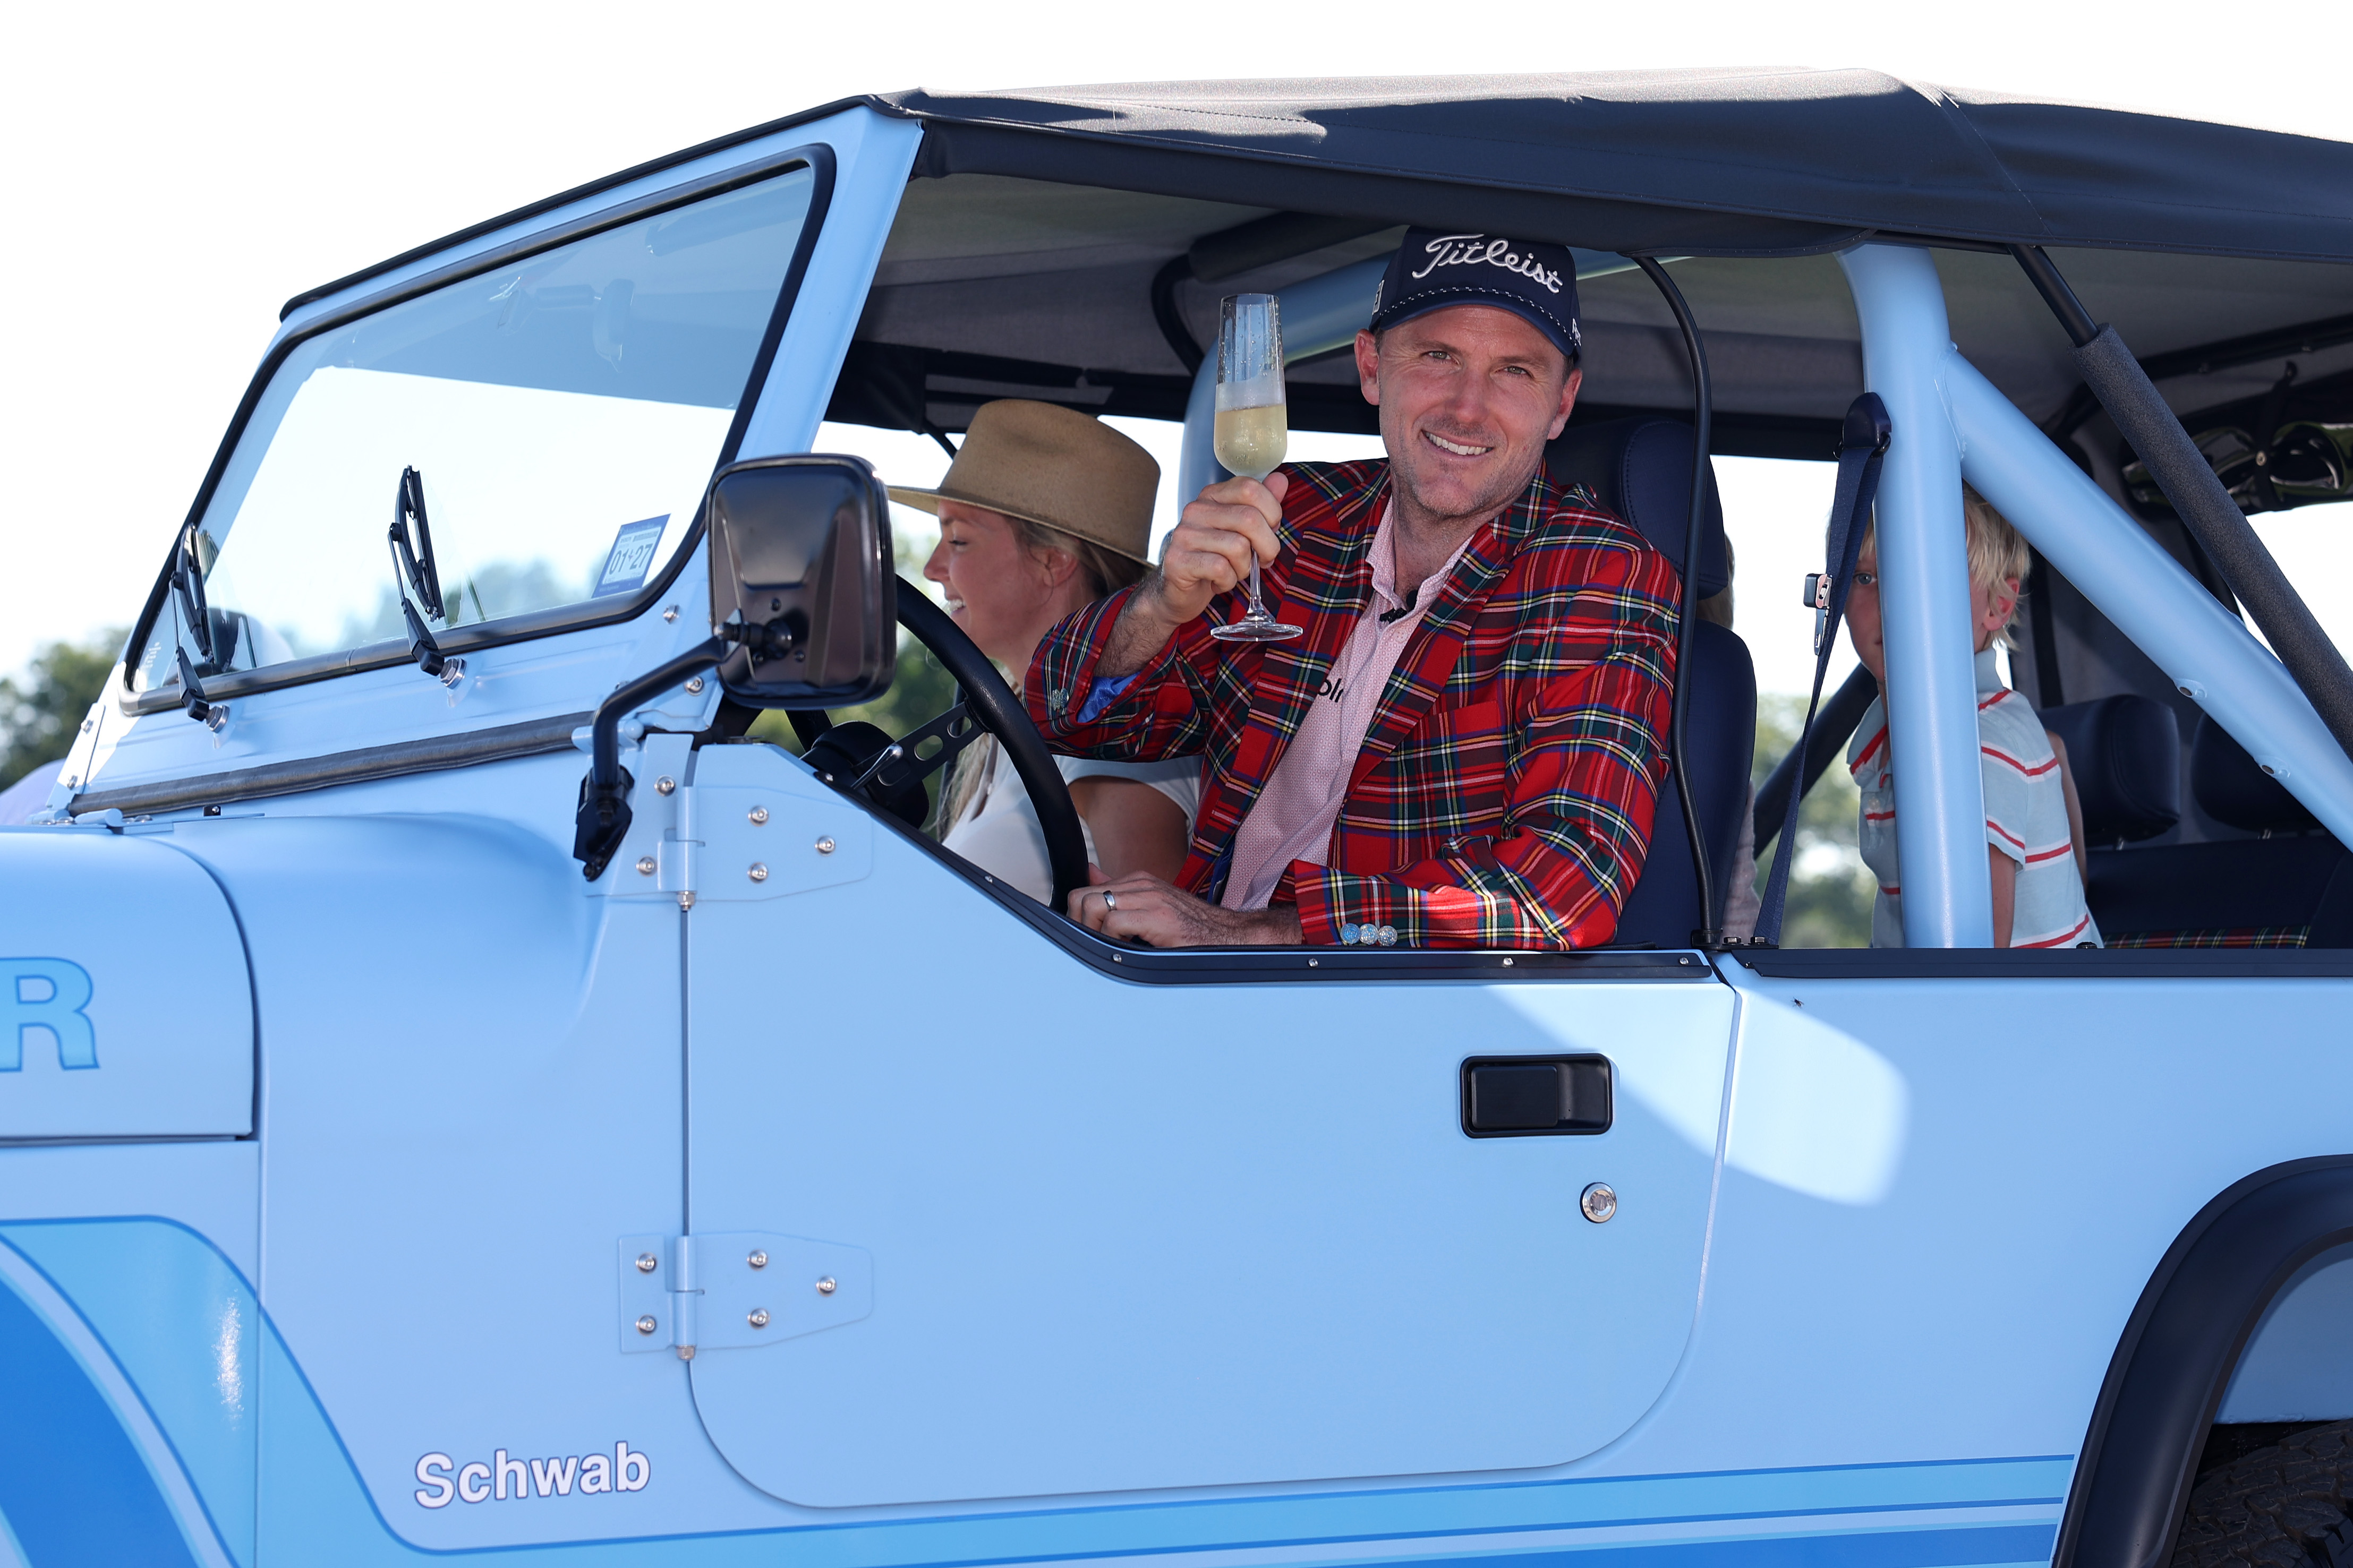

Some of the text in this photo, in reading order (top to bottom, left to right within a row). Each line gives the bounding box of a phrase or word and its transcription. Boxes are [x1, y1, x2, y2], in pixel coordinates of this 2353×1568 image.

[1412, 233, 1563, 294] Titleist
[609, 543, 654, 575] 01 27
[0, 957, 100, 1072] R
[414, 1440, 651, 1509] Schwab
